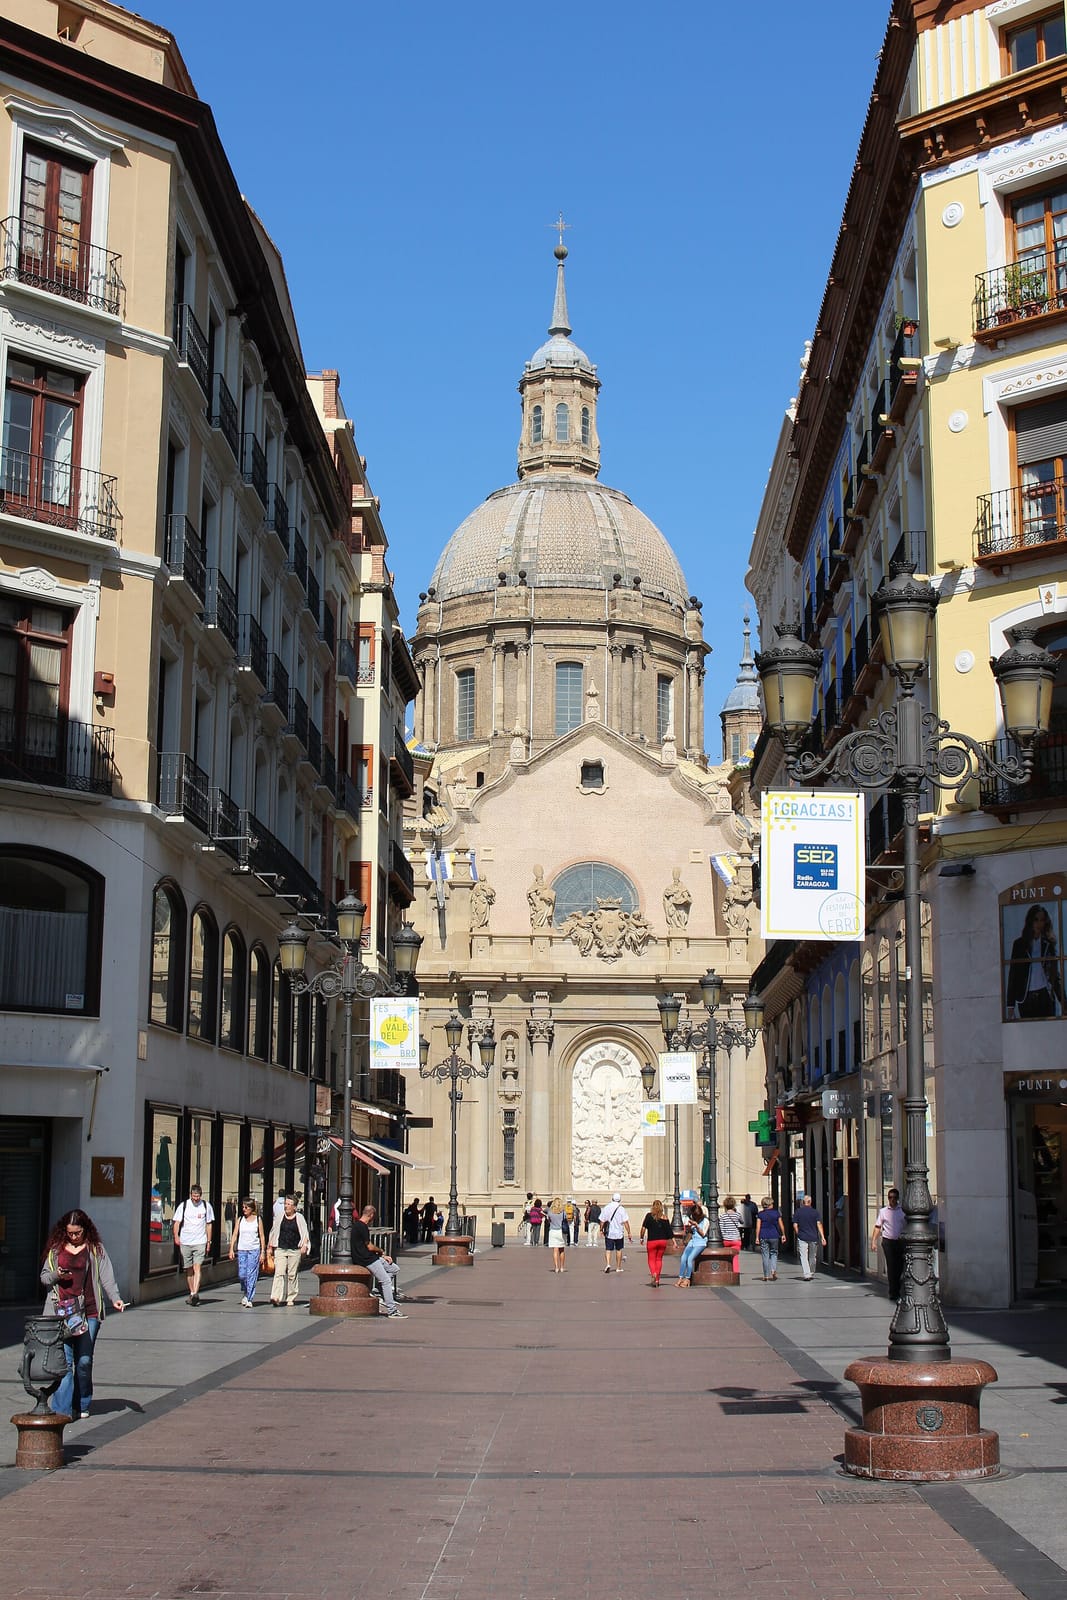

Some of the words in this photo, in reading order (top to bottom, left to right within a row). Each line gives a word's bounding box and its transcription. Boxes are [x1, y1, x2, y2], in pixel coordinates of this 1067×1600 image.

[797, 850, 835, 863] SER
[1012, 887, 1046, 900] PUNT
[828, 917, 860, 933] EBRO
[386, 1023, 413, 1032] VALES
[1019, 1079, 1052, 1091] PUNT
